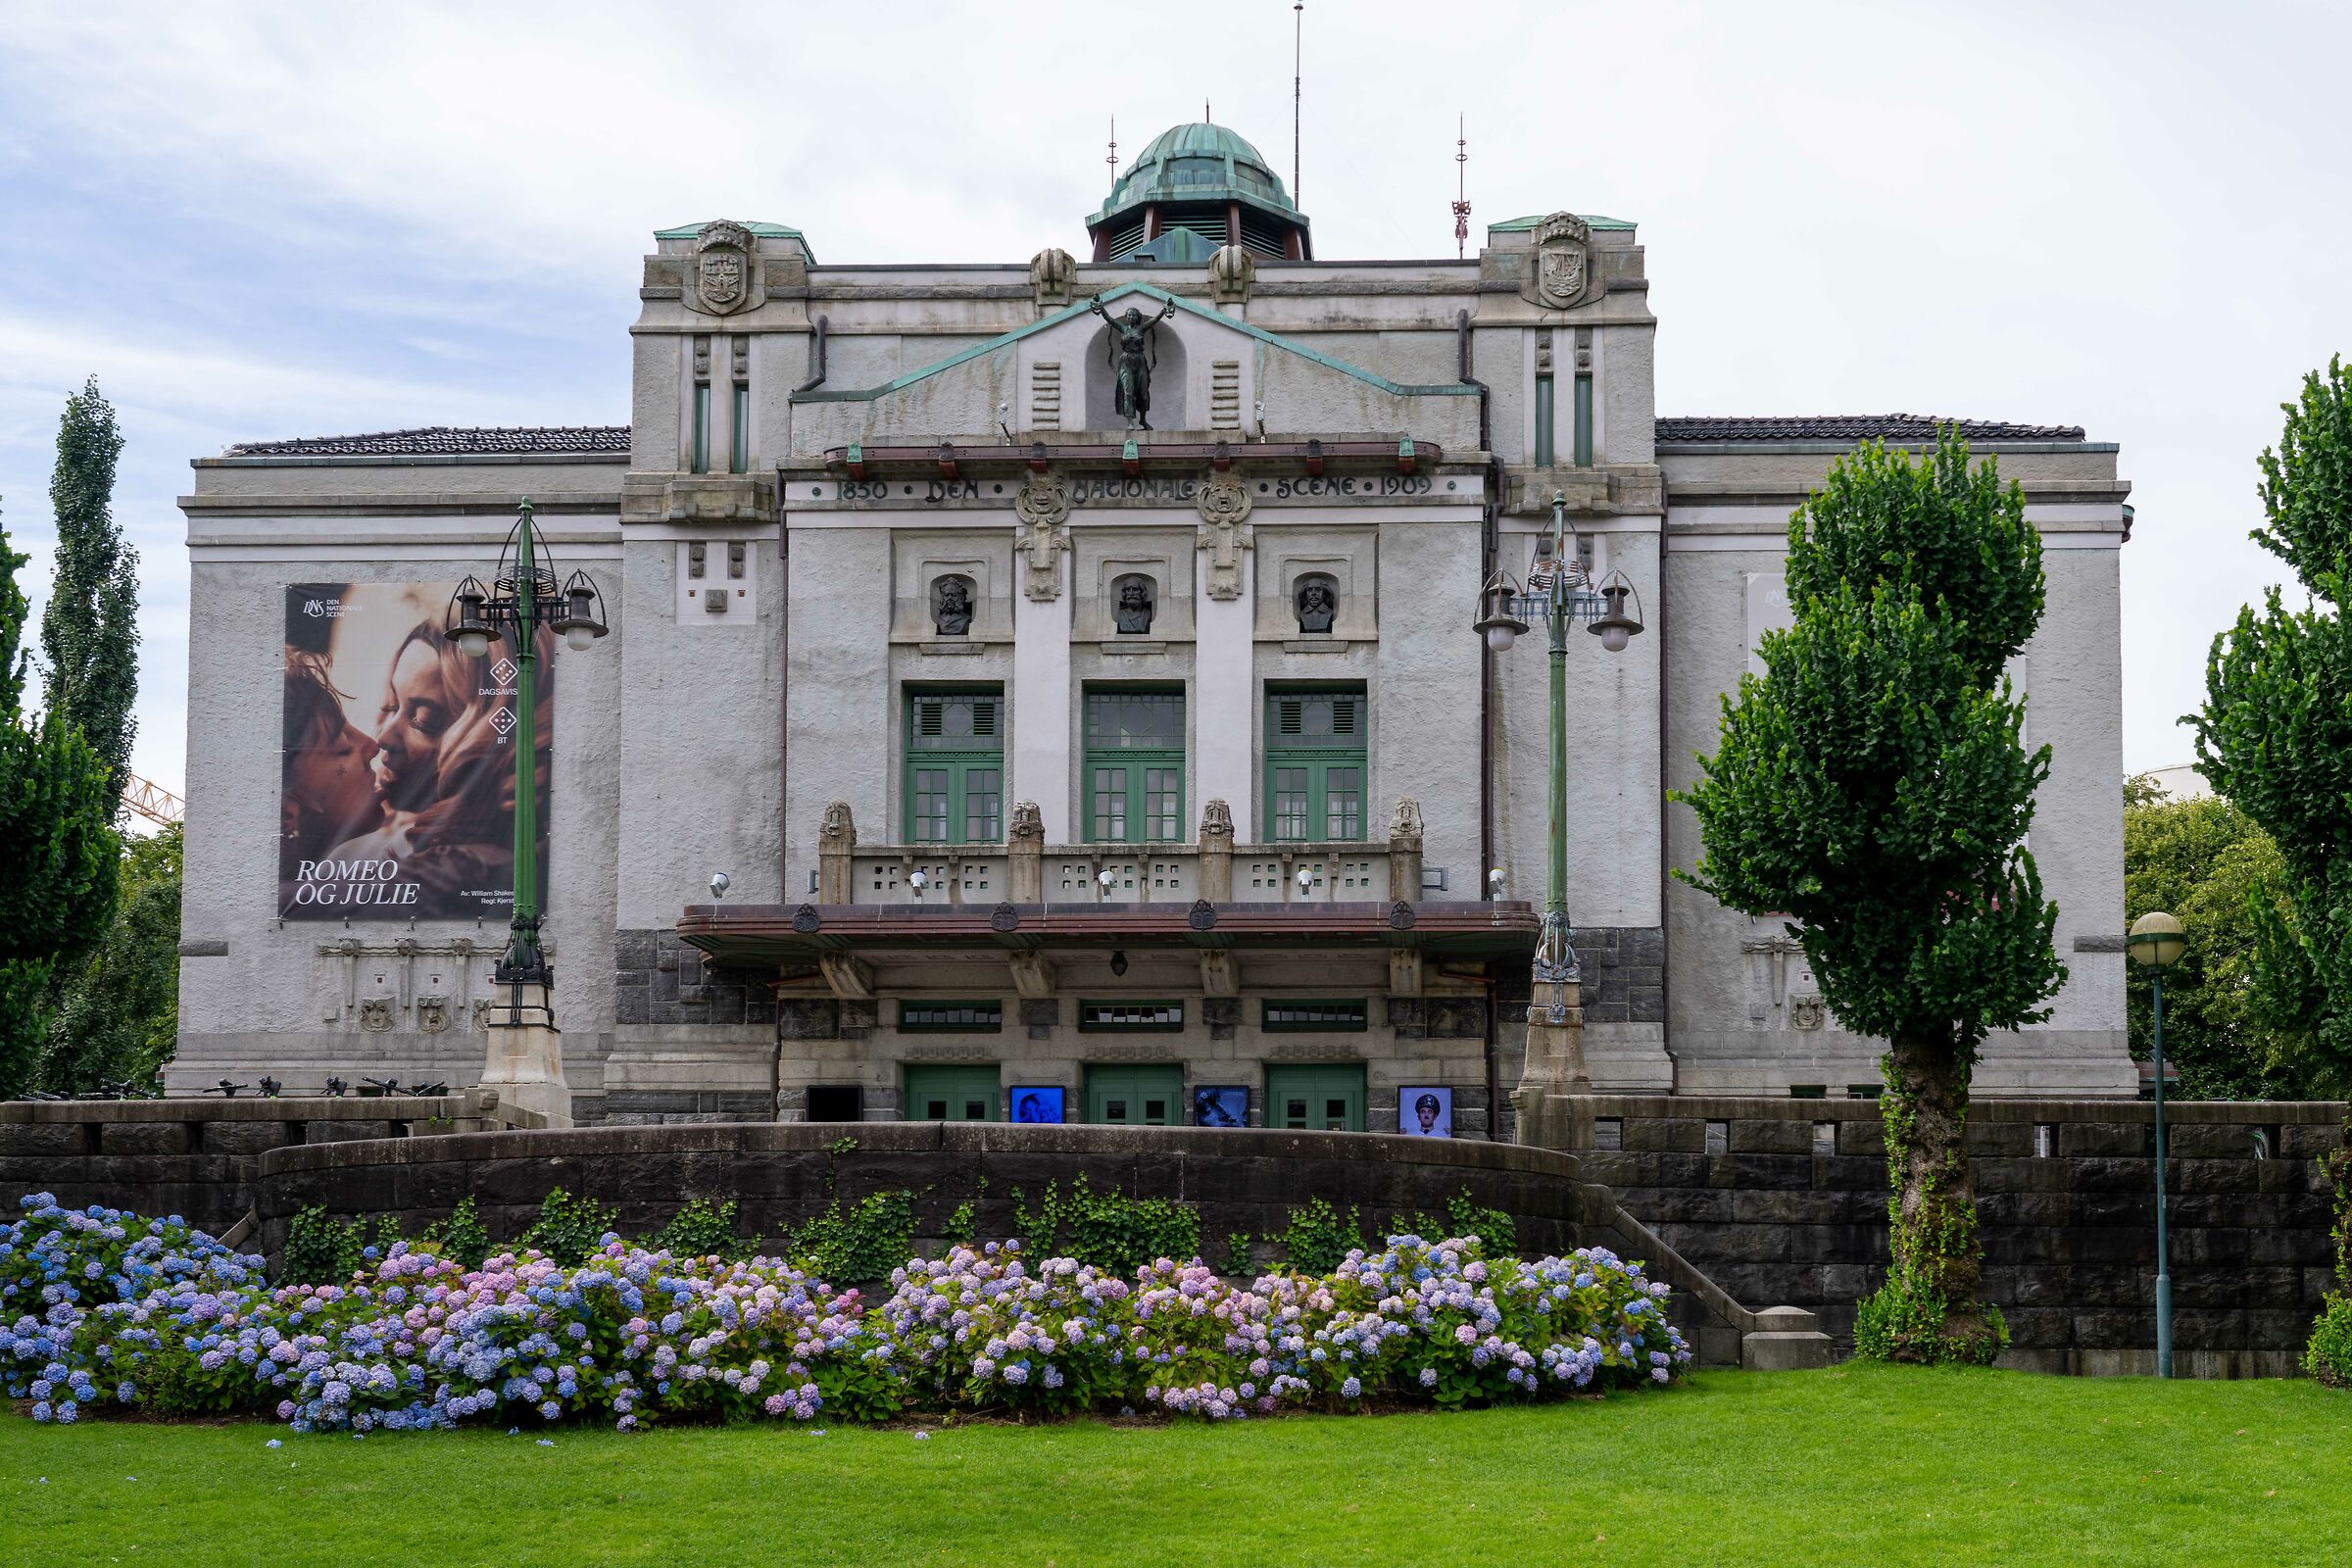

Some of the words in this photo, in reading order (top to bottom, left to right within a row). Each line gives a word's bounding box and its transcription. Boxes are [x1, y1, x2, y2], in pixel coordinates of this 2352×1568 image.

[836, 478, 889, 501] 1850
[925, 478, 979, 503] DEN
[1276, 476, 1357, 499] SCENE
[1380, 476, 1433, 496] 1909
[294, 858, 399, 882] ROMEO
[295, 883, 337, 906] OG
[339, 883, 420, 906] JULIE
